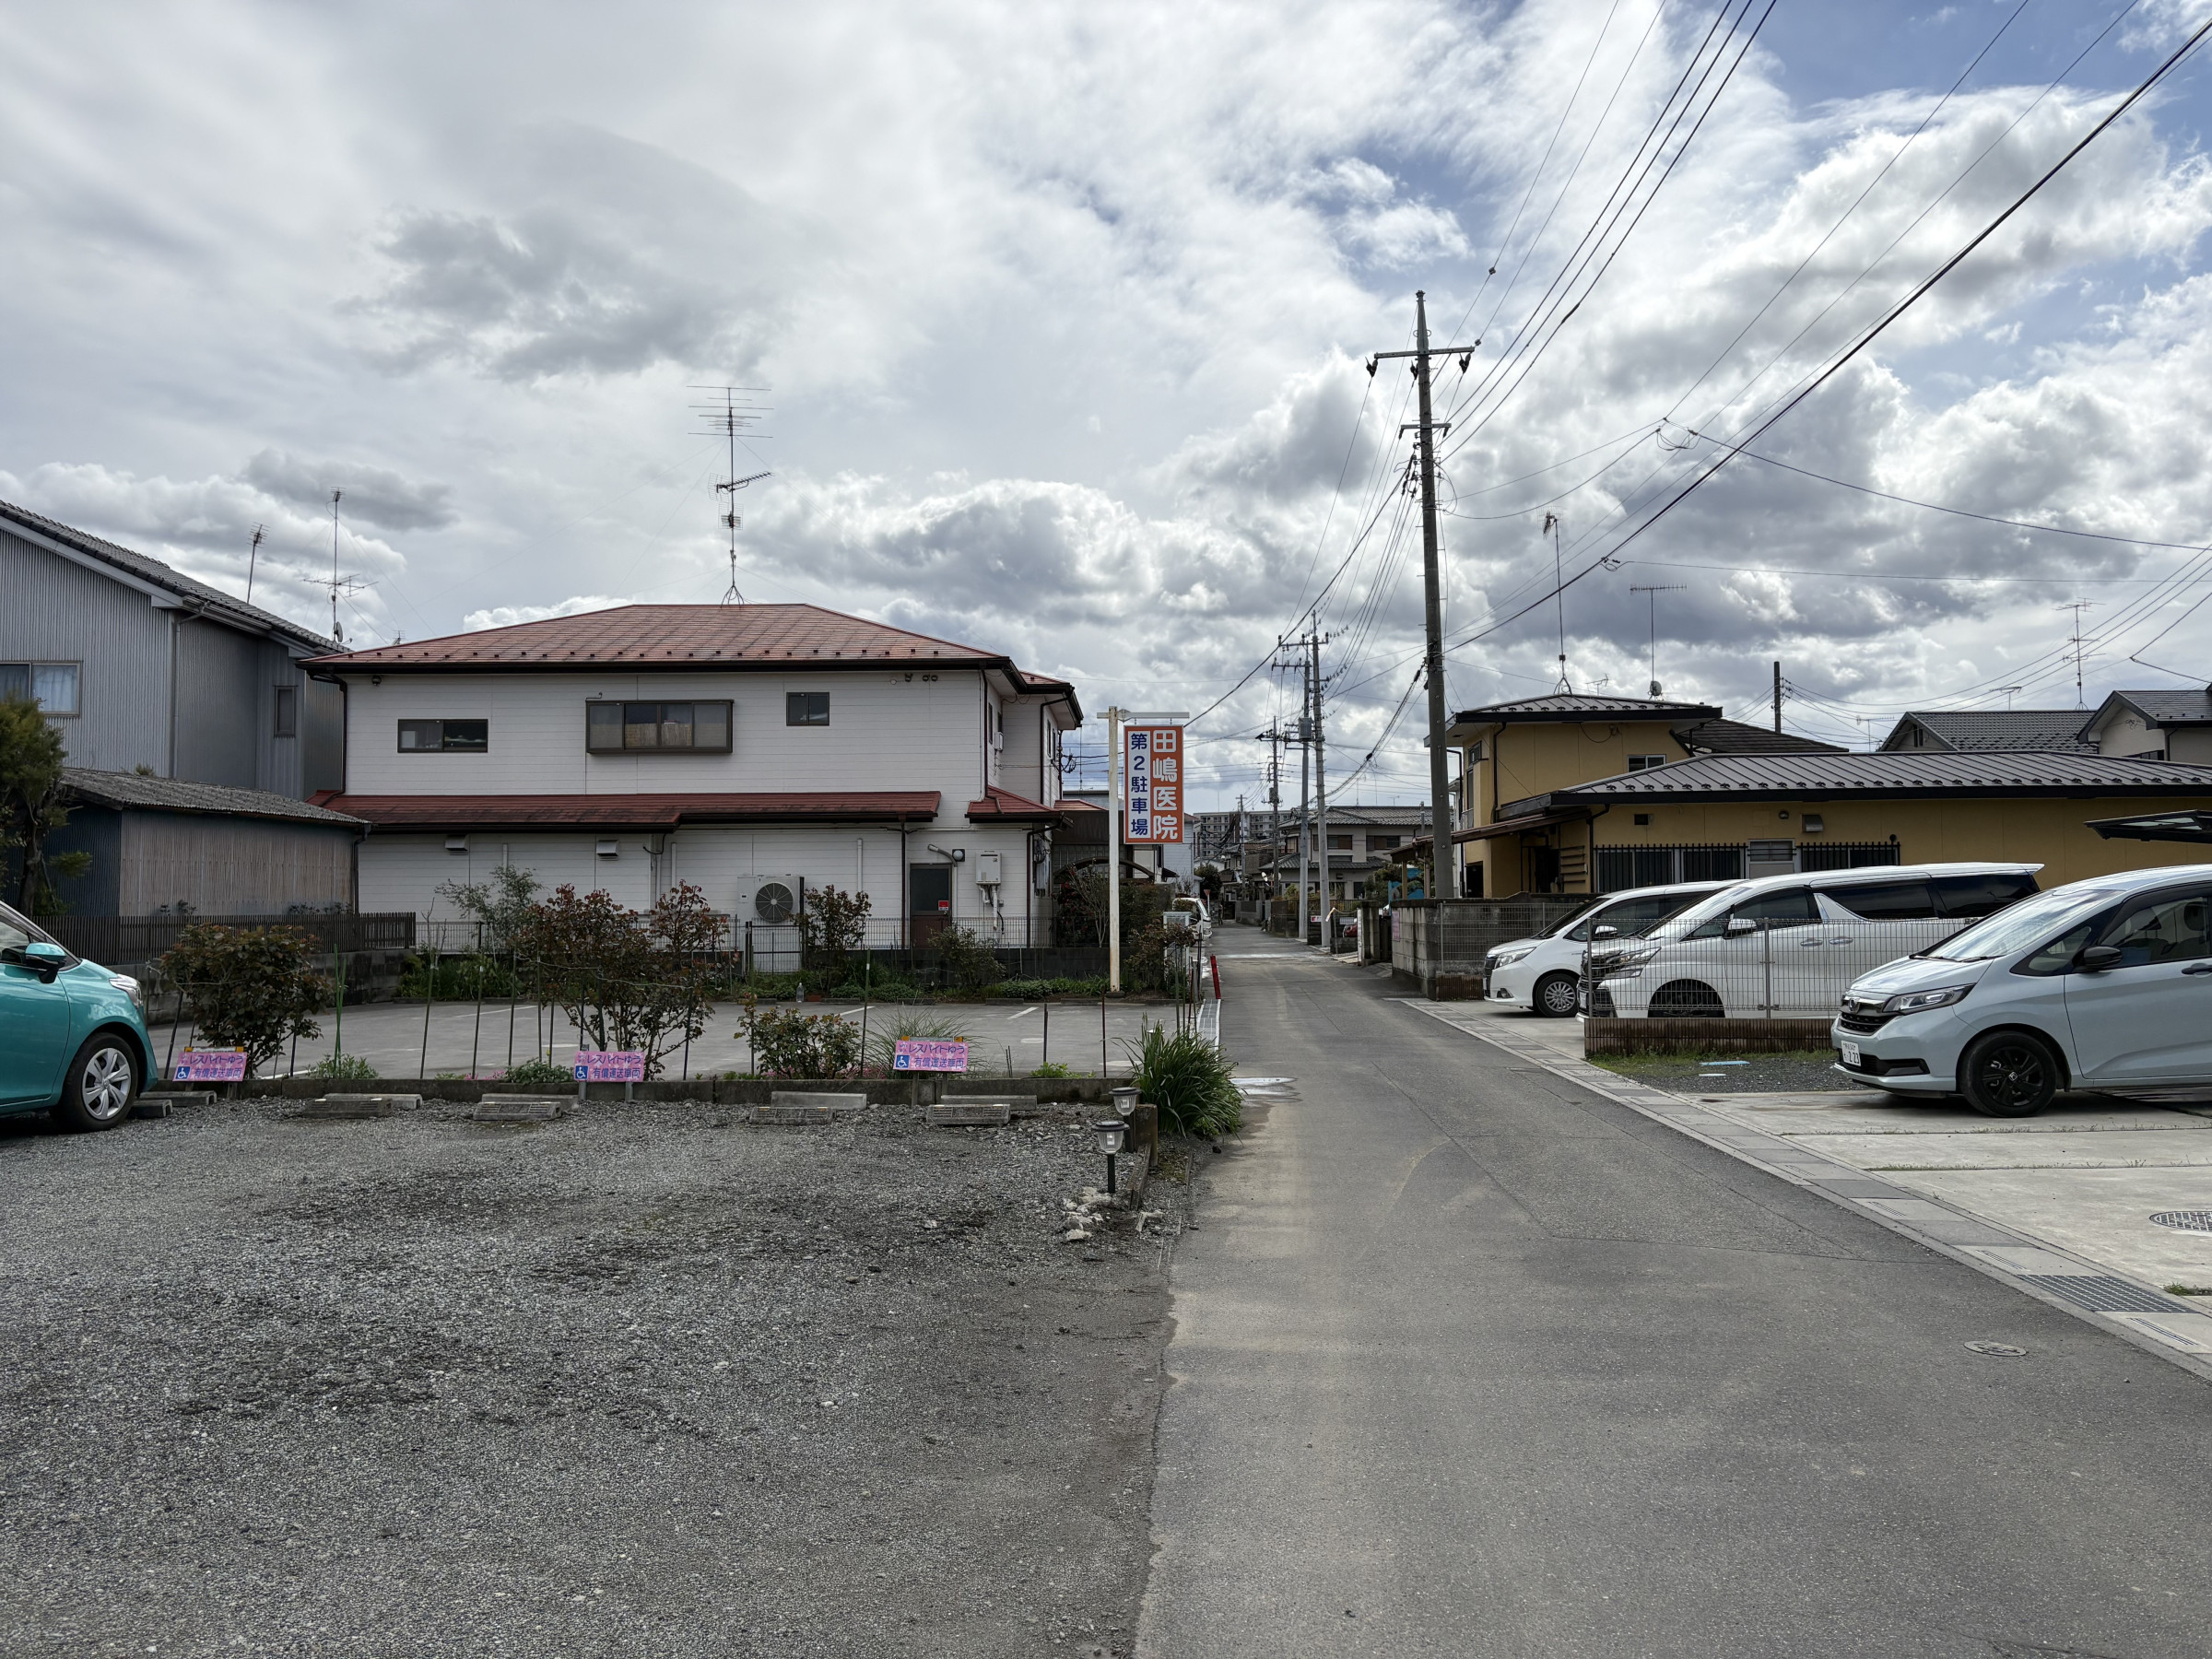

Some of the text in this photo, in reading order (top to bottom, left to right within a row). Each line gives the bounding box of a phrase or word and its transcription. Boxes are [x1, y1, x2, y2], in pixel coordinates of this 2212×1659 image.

[1130, 733, 1148, 836] 第2駐車場
[1152, 729, 1179, 841] 田嶋医院
